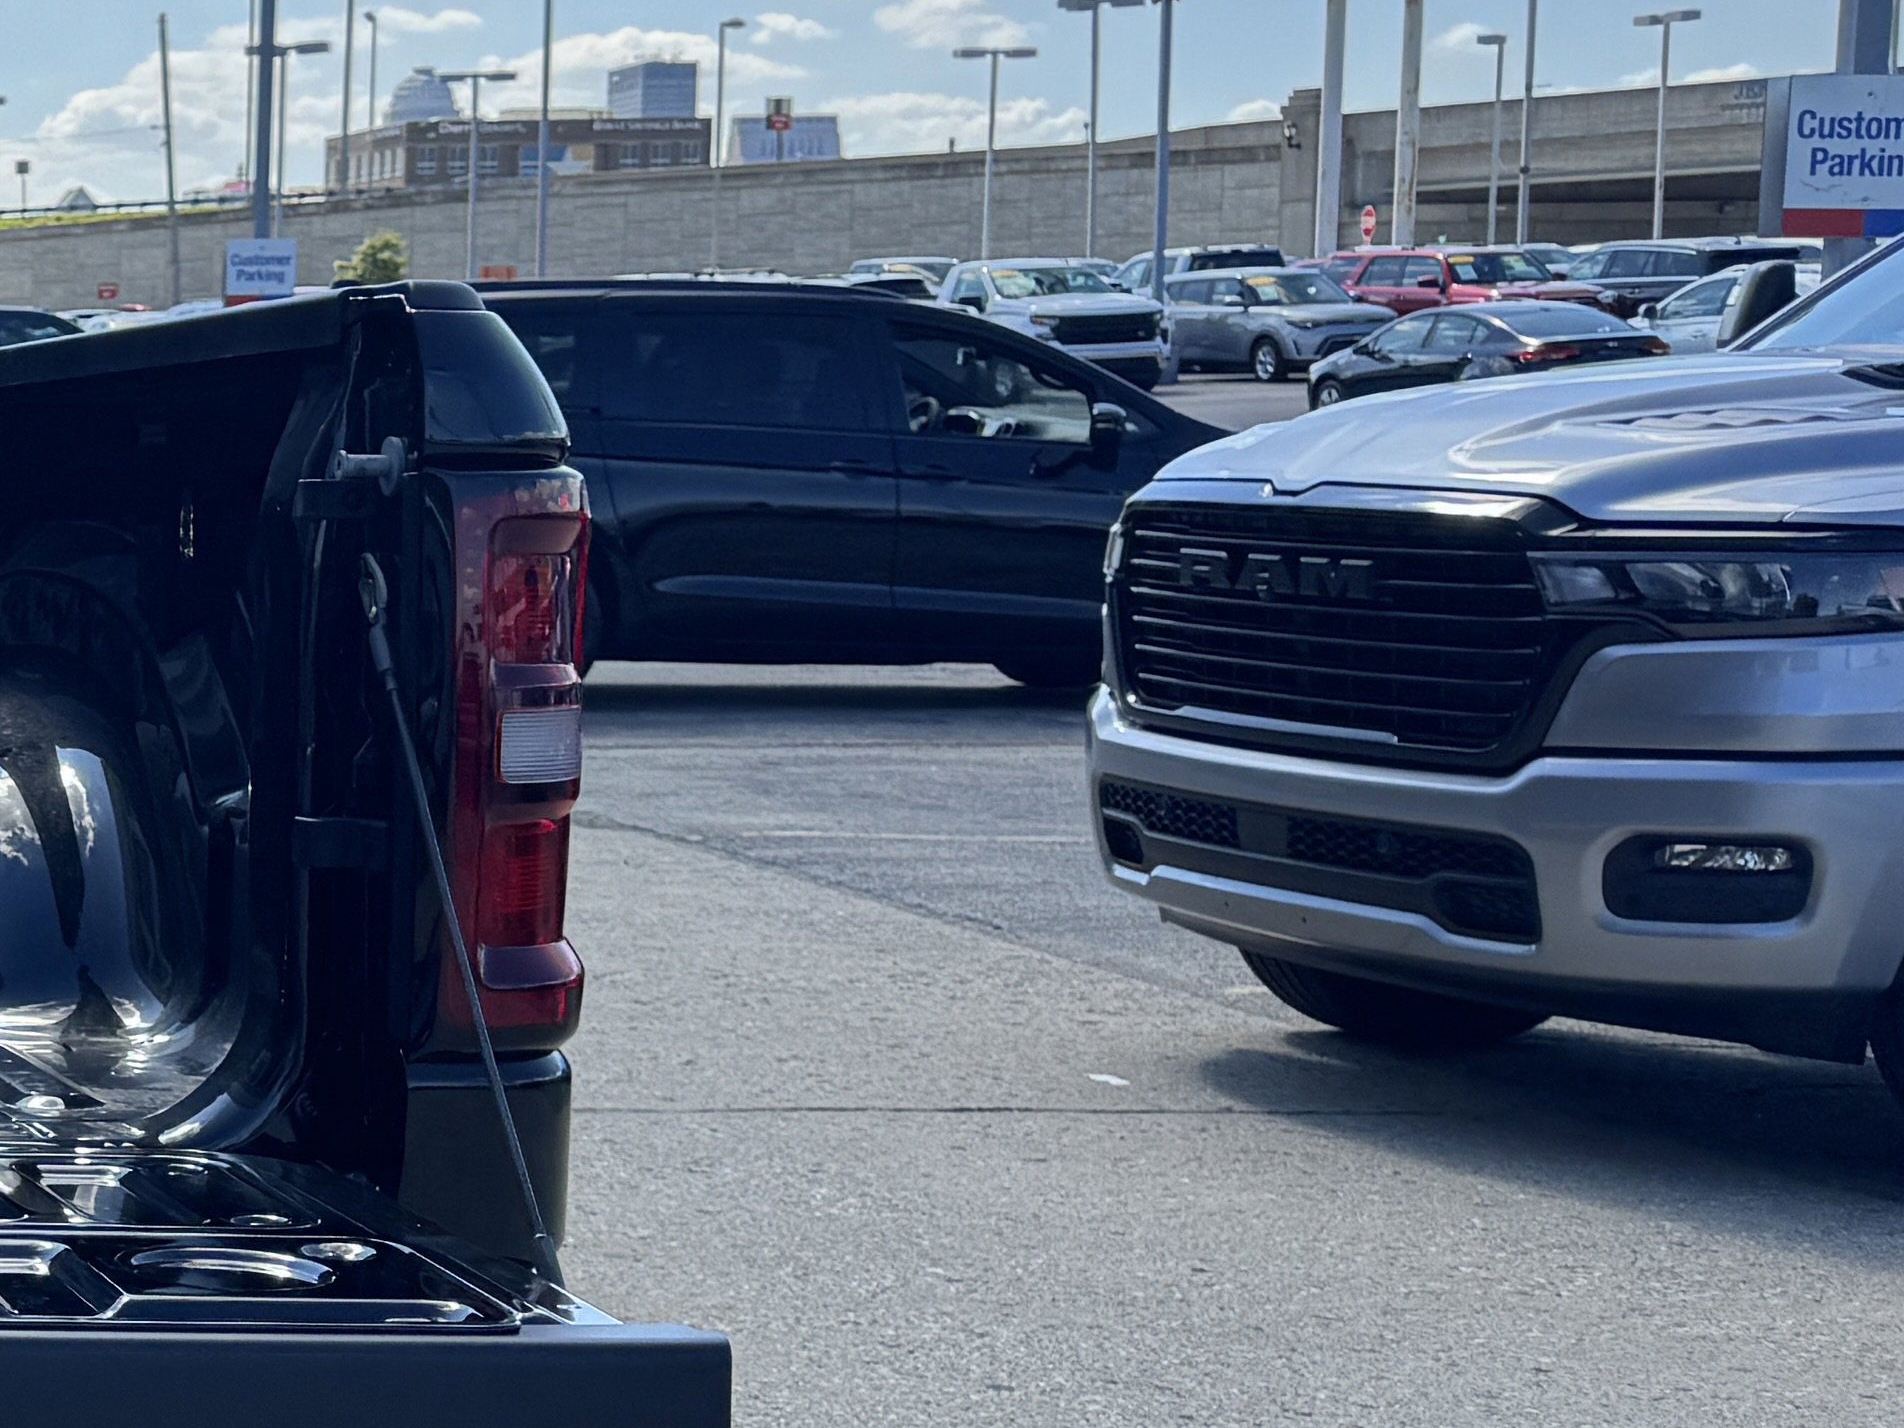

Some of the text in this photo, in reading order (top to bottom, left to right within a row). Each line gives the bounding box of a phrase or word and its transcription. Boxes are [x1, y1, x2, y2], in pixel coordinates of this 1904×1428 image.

[230, 253, 291, 267] Customer
[235, 269, 286, 284] Parking
[1178, 547, 1375, 600] RAM
